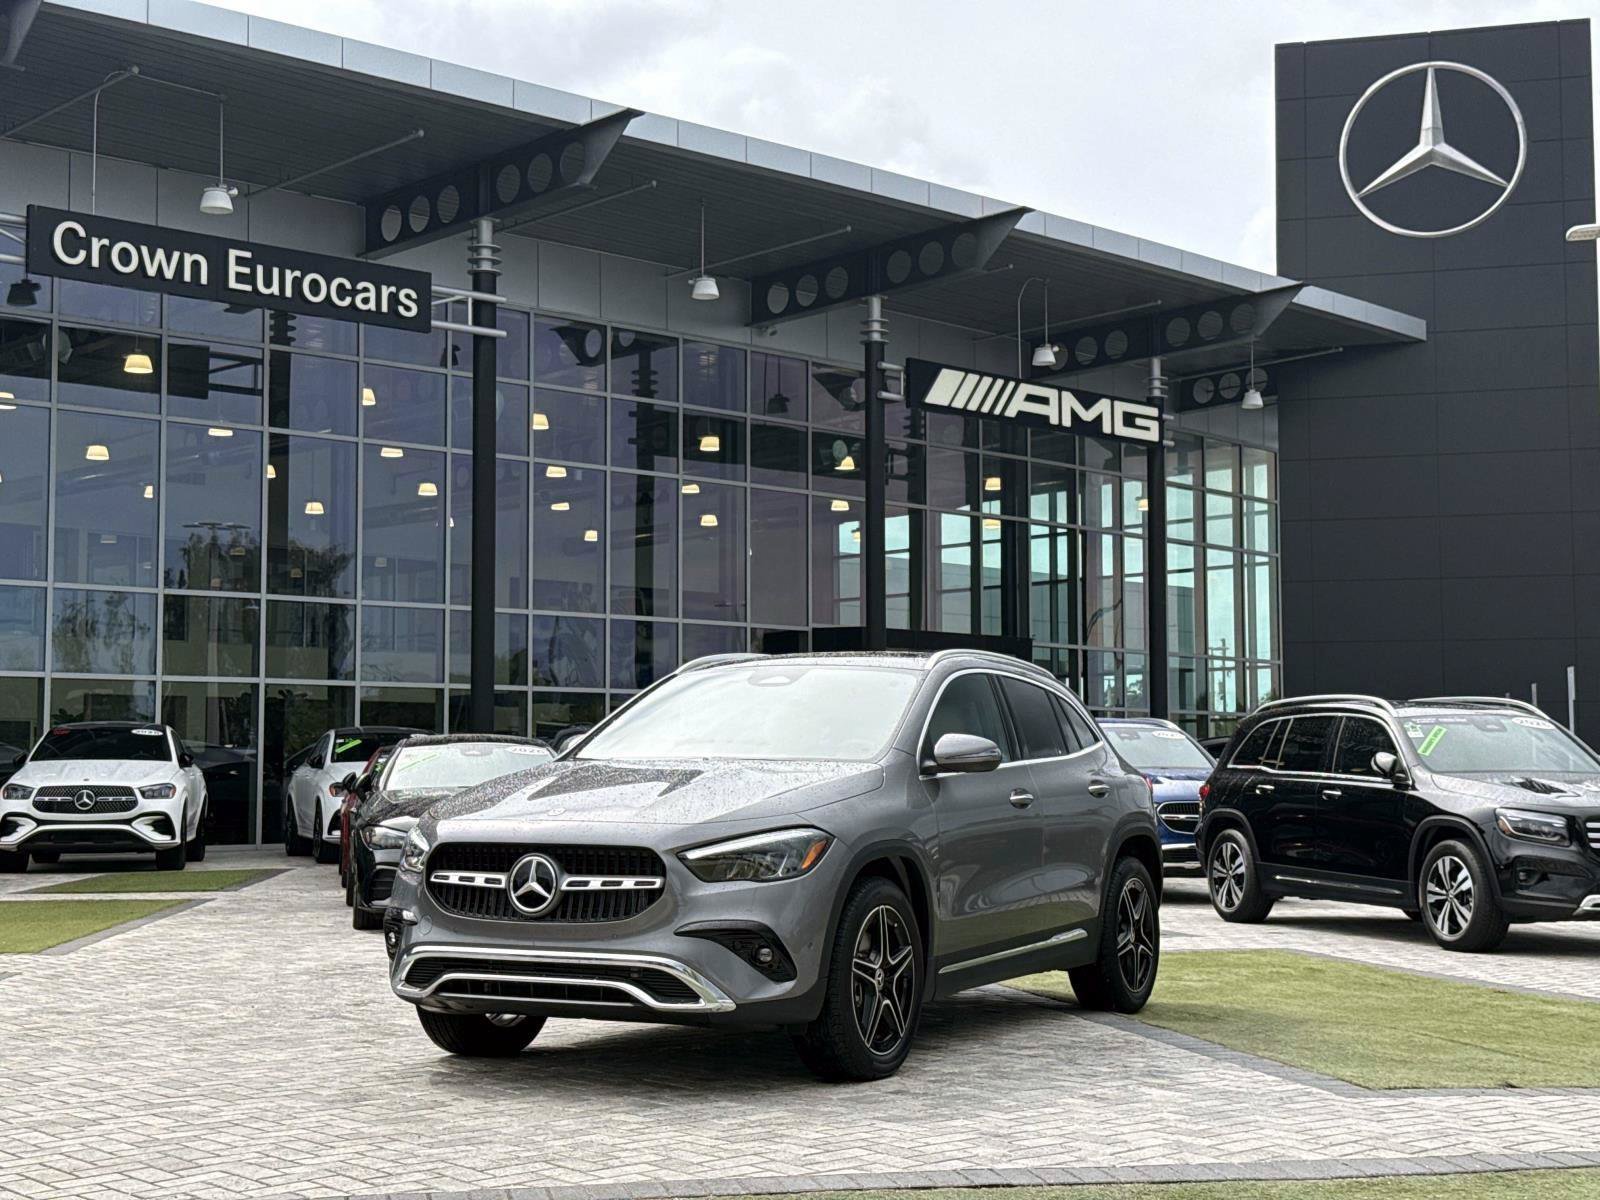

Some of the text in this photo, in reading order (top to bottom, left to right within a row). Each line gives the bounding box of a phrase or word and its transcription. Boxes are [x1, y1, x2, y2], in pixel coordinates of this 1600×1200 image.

[52, 220, 419, 318] Crown Eurocars
[1004, 382, 1160, 443] AMG
